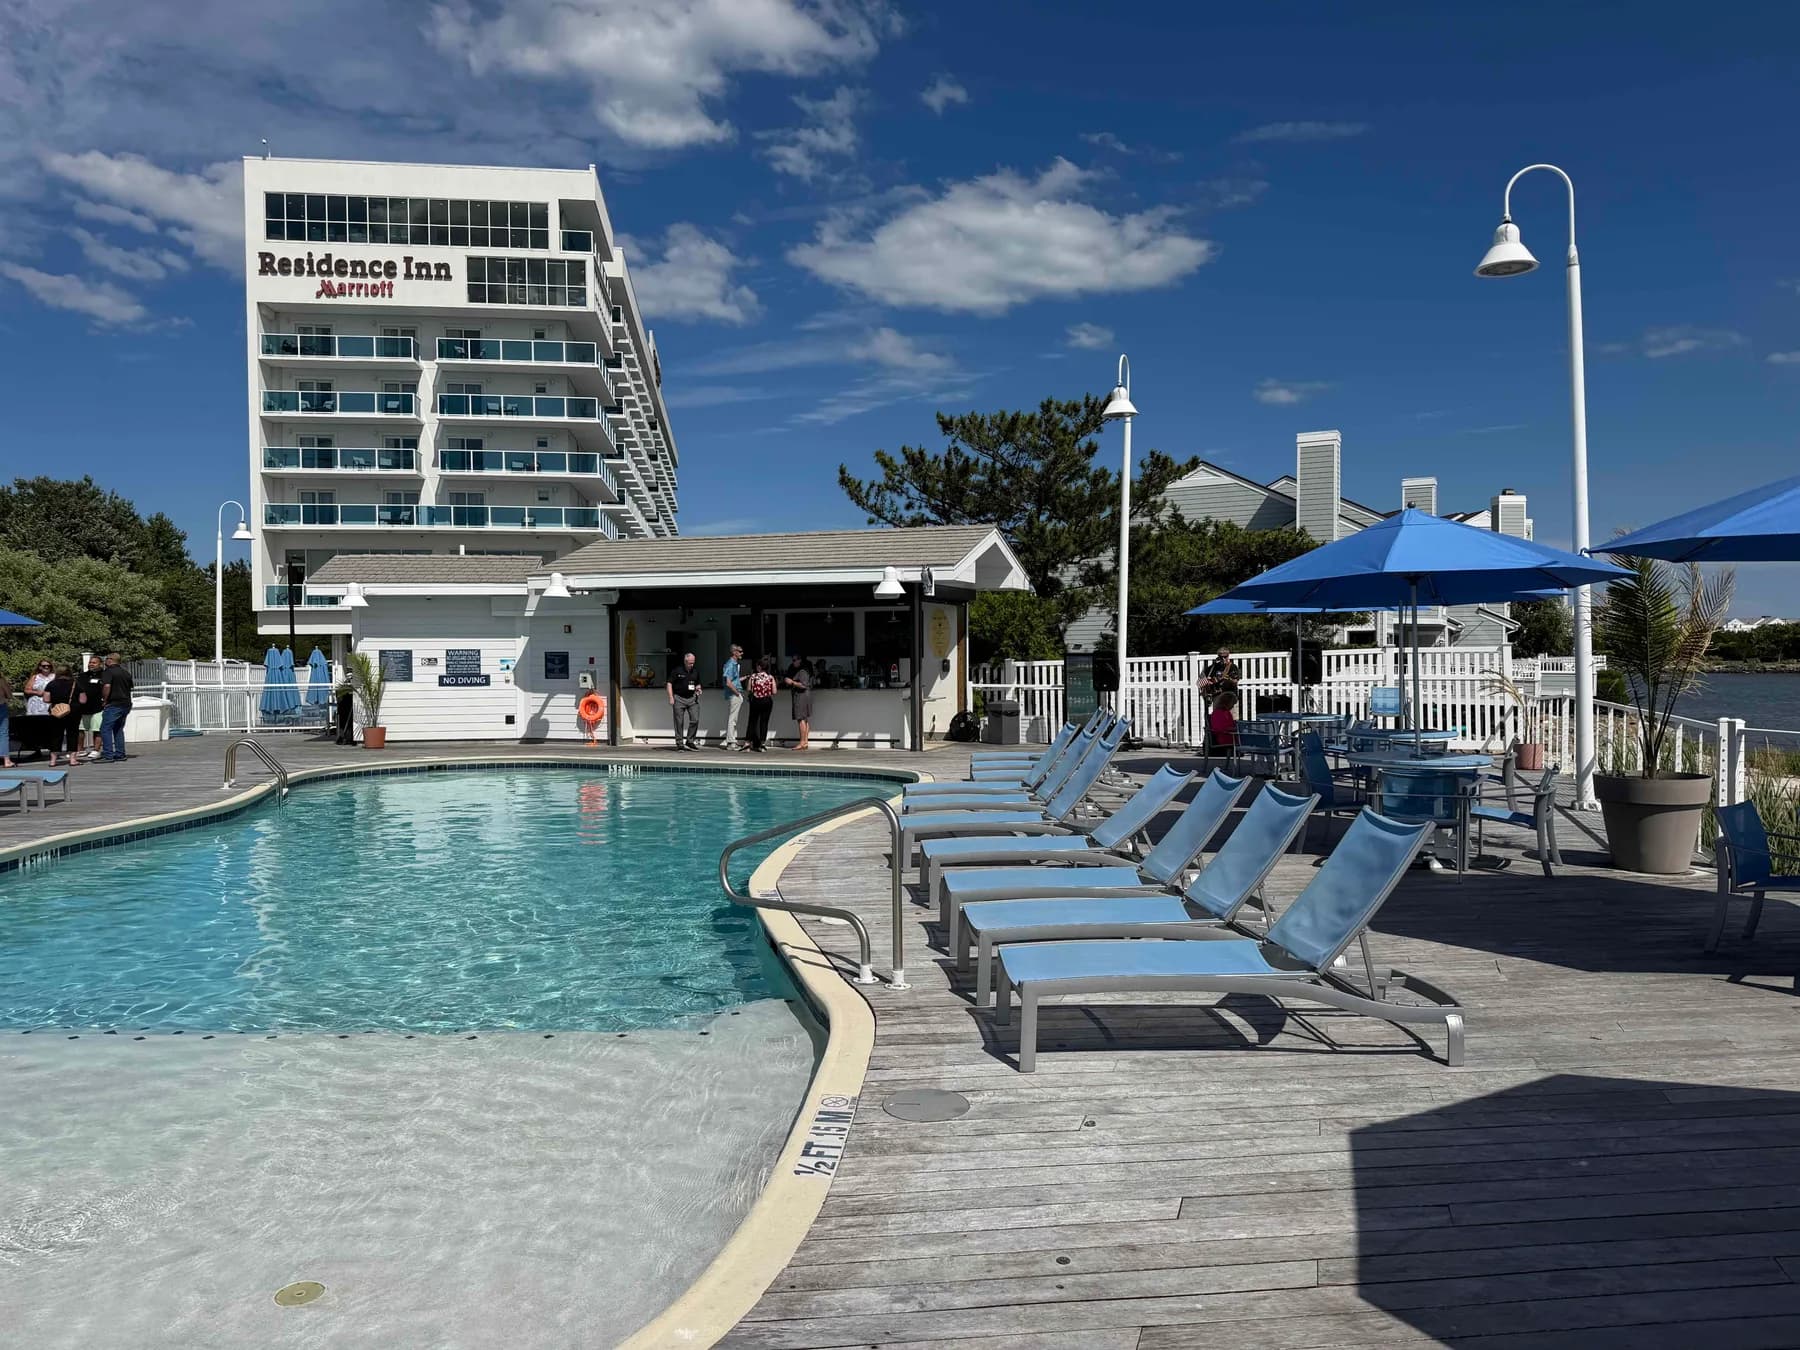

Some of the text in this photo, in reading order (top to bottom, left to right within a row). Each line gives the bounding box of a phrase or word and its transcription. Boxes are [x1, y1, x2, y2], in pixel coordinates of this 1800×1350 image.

[258, 251, 453, 281] Residence Inn
[315, 279, 394, 298] Marriott
[815, 1110, 853, 1123] M
[800, 1141, 842, 1159] FT
